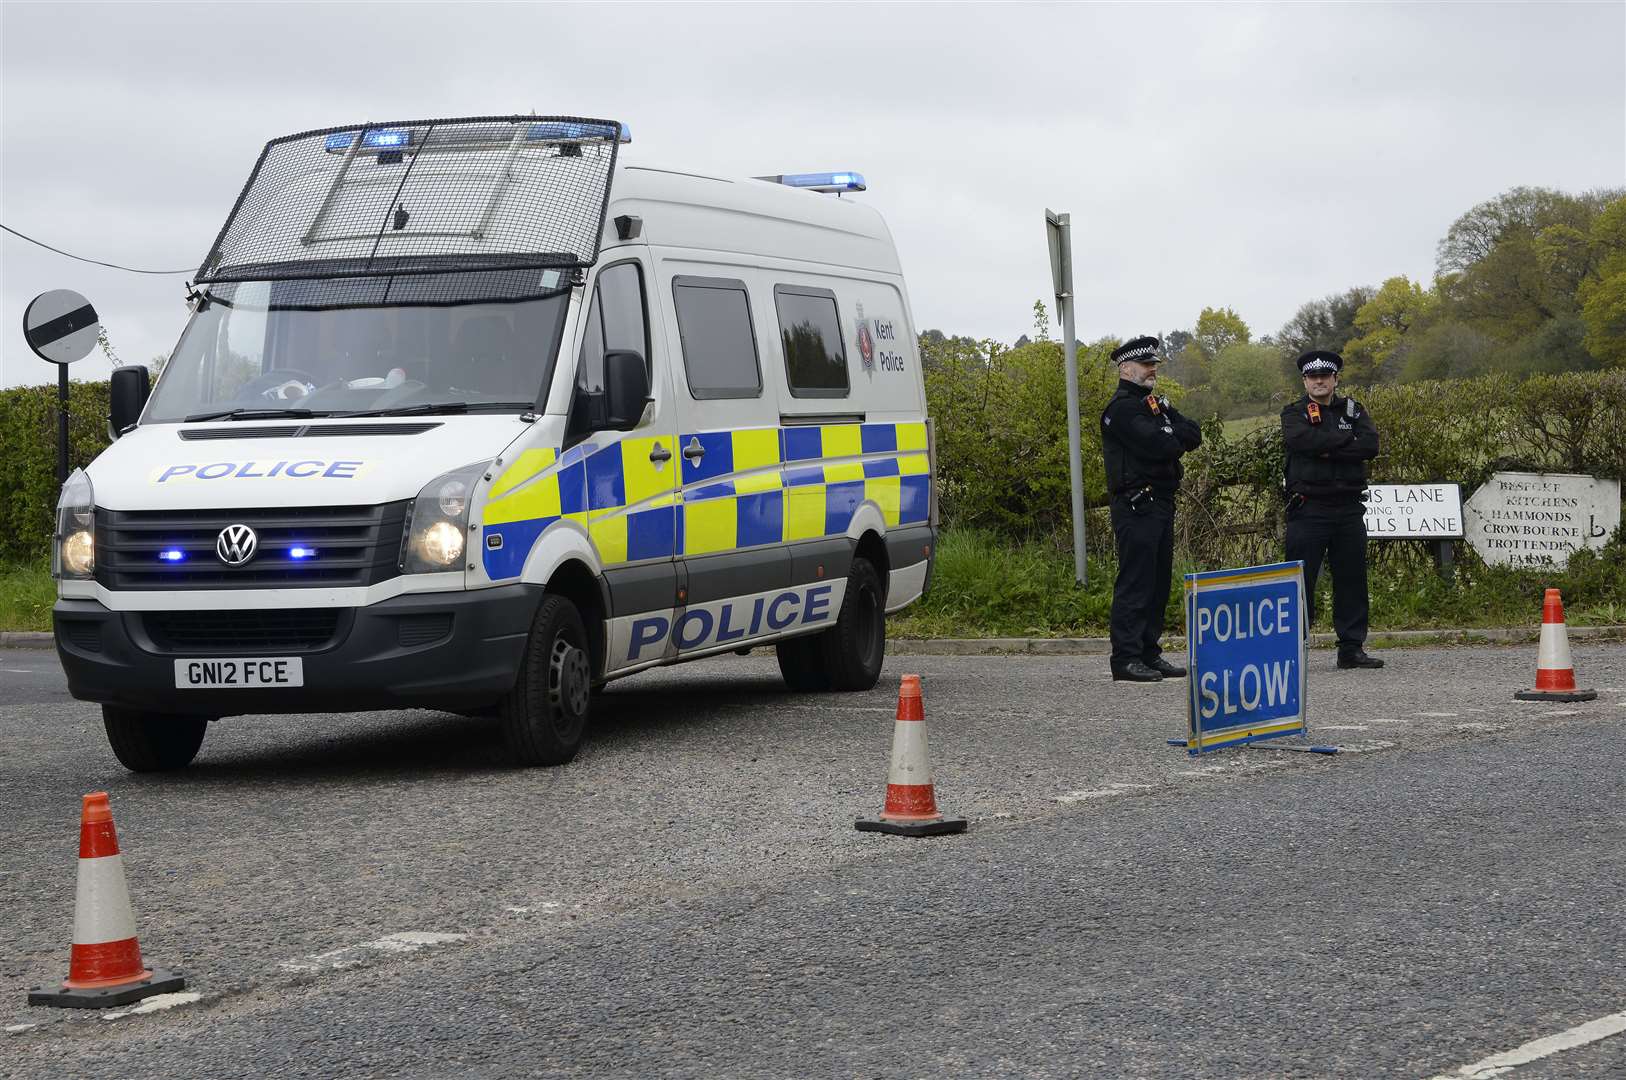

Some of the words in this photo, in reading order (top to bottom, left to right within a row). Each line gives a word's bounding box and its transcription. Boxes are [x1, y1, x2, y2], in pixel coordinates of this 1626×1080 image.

[874, 319, 895, 340] Kent
[879, 351, 905, 372] Police
[157, 460, 364, 483] POLICE
[1394, 488, 1445, 503] LANE
[1398, 506, 1414, 515] TO
[1492, 510, 1572, 522] HAMMONDS
[1407, 517, 1457, 532] LANE
[1483, 523, 1580, 537] CROWBOURNE
[1486, 538, 1577, 552] TROTTENDEN
[627, 585, 832, 661] POLICE
[1198, 597, 1291, 645] POLICE
[188, 661, 237, 684] GN12
[243, 661, 289, 684] FCE
[1200, 659, 1291, 719] SLOW
